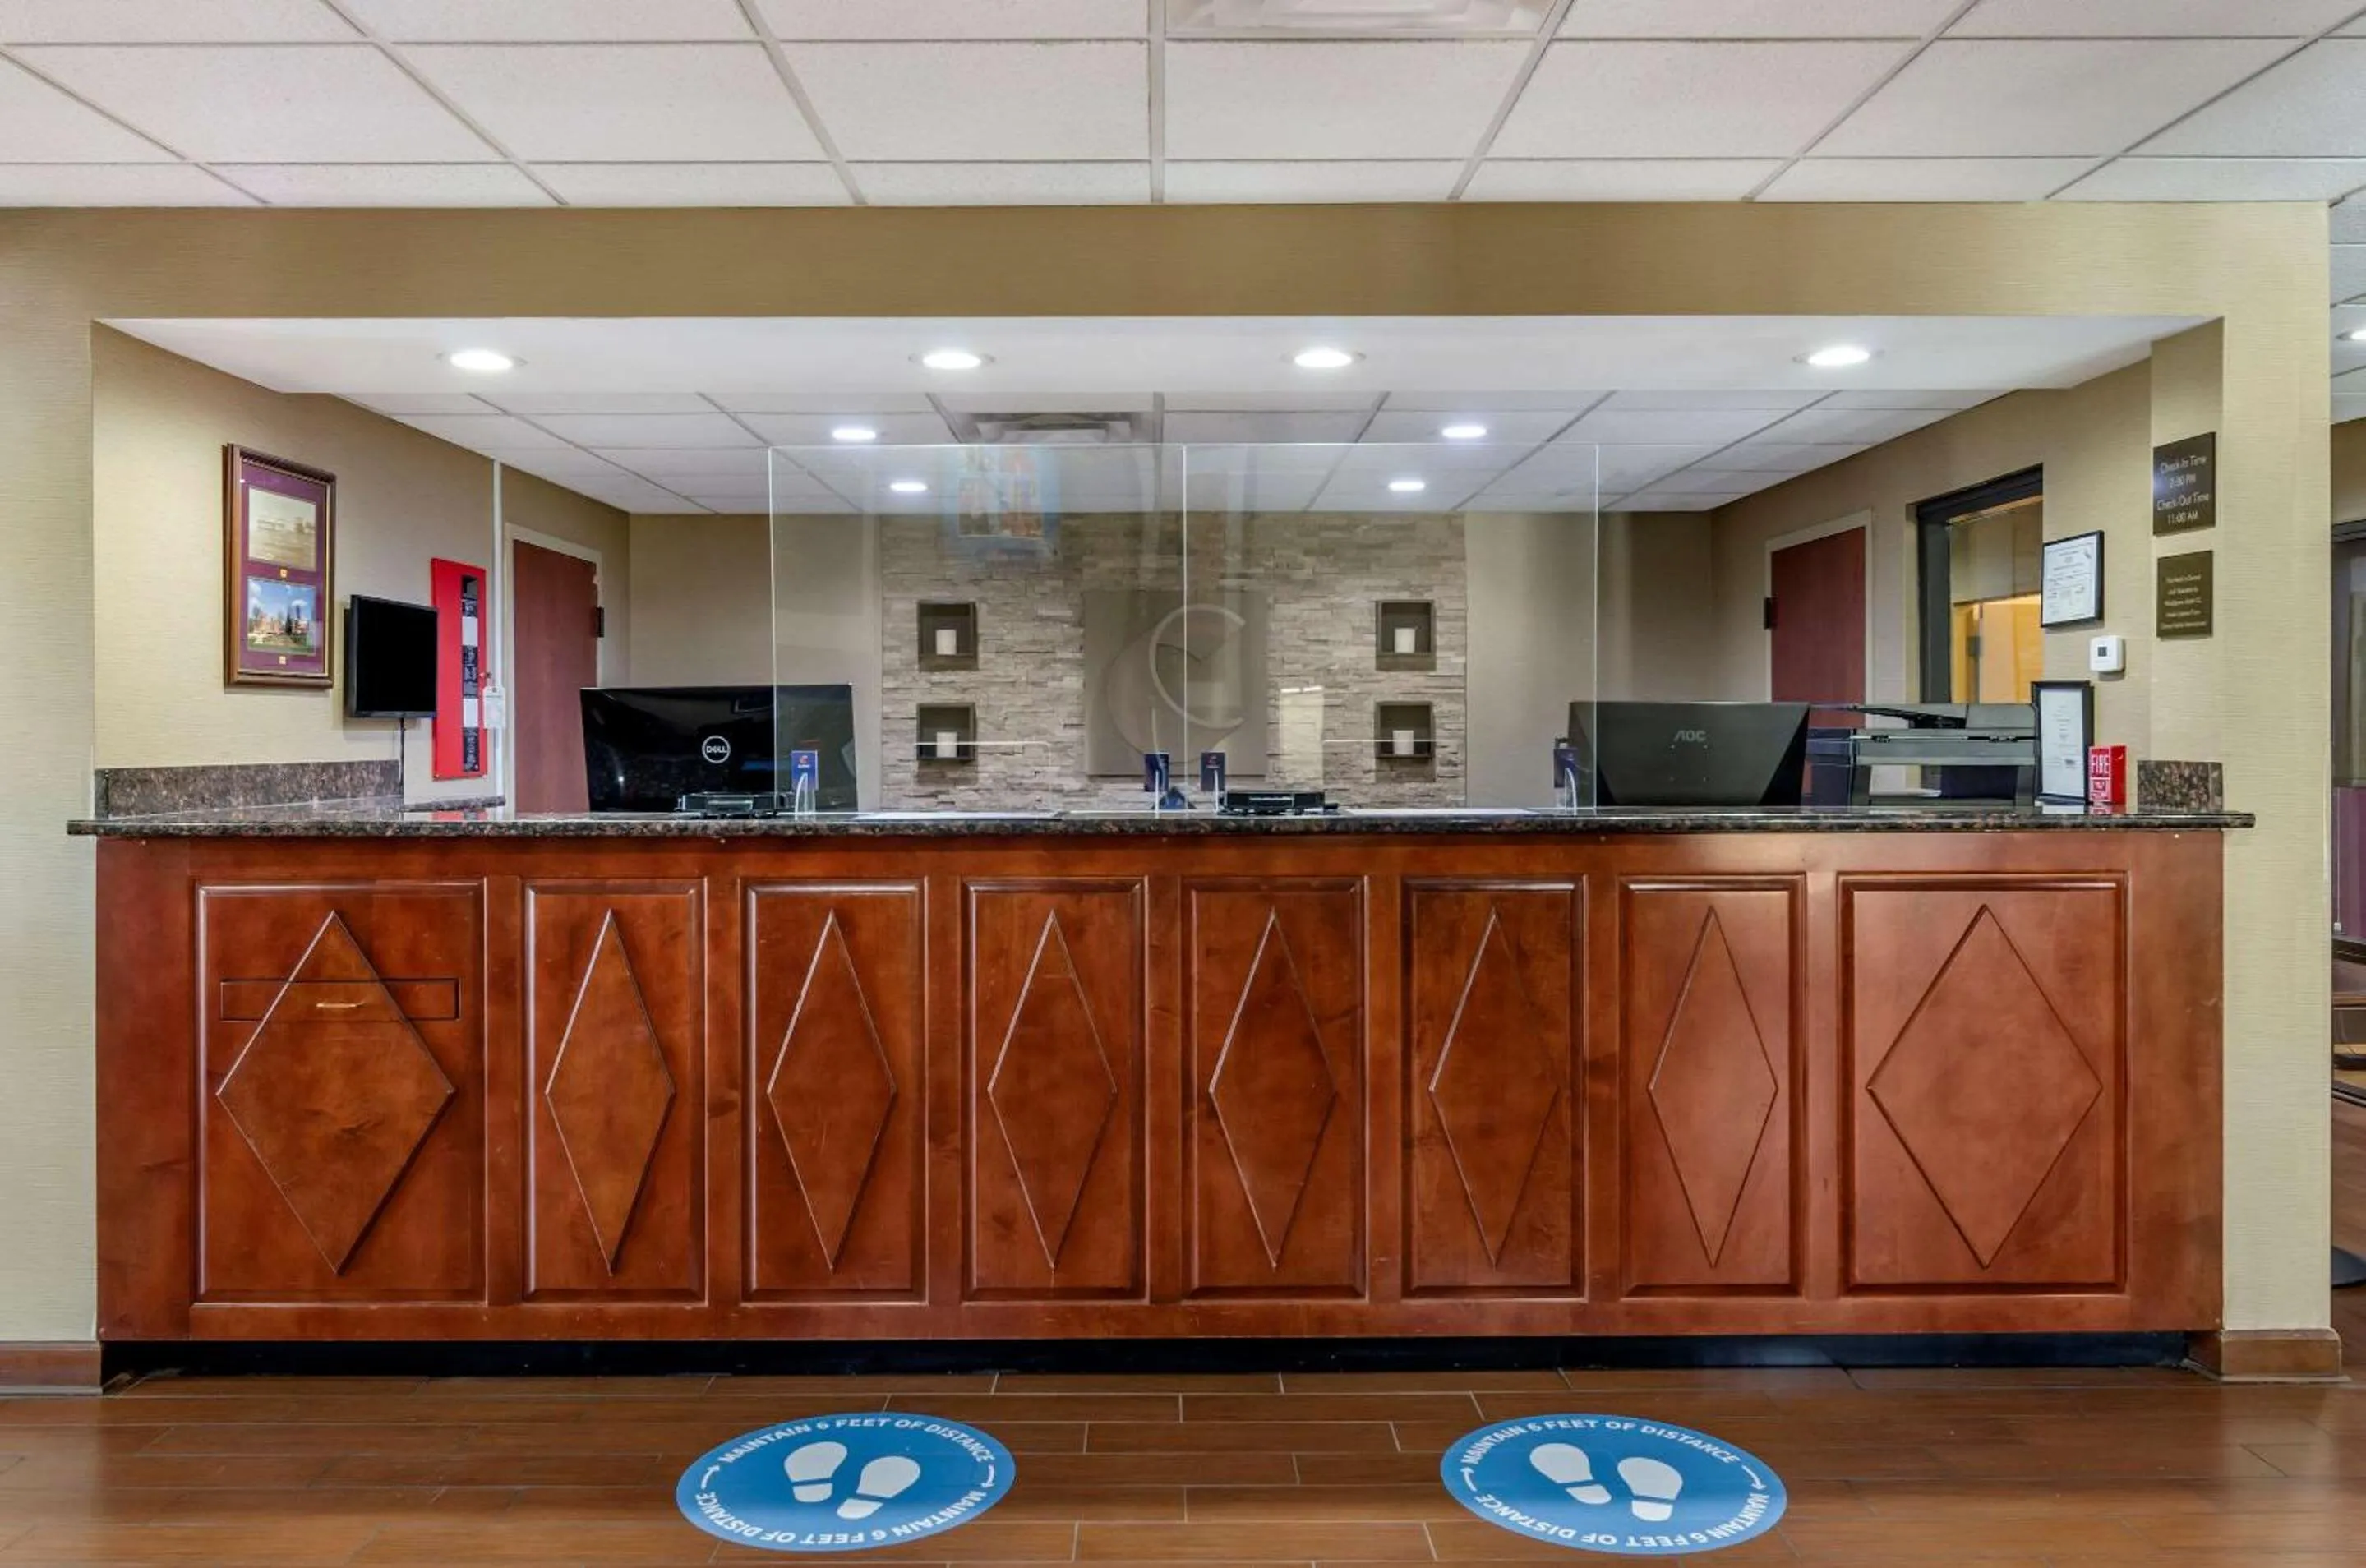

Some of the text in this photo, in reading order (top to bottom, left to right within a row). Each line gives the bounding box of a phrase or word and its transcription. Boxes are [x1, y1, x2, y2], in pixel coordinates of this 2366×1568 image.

[2187, 510, 2198, 522] AM
[706, 745, 728, 754] DELL
[1673, 730, 1706, 742] AOC
[717, 1418, 996, 1464] MAINTAIN 6 FEET OF DISTANCE
[1460, 1419, 1741, 1464] MAINTAIN 6 FEET OF DISTANCE
[694, 1489, 987, 1544] MAINTAIN 6 FEET OF DISTANCE
[1474, 1492, 1770, 1547] MAINTAIN 6 FEET OF DISTANCE
